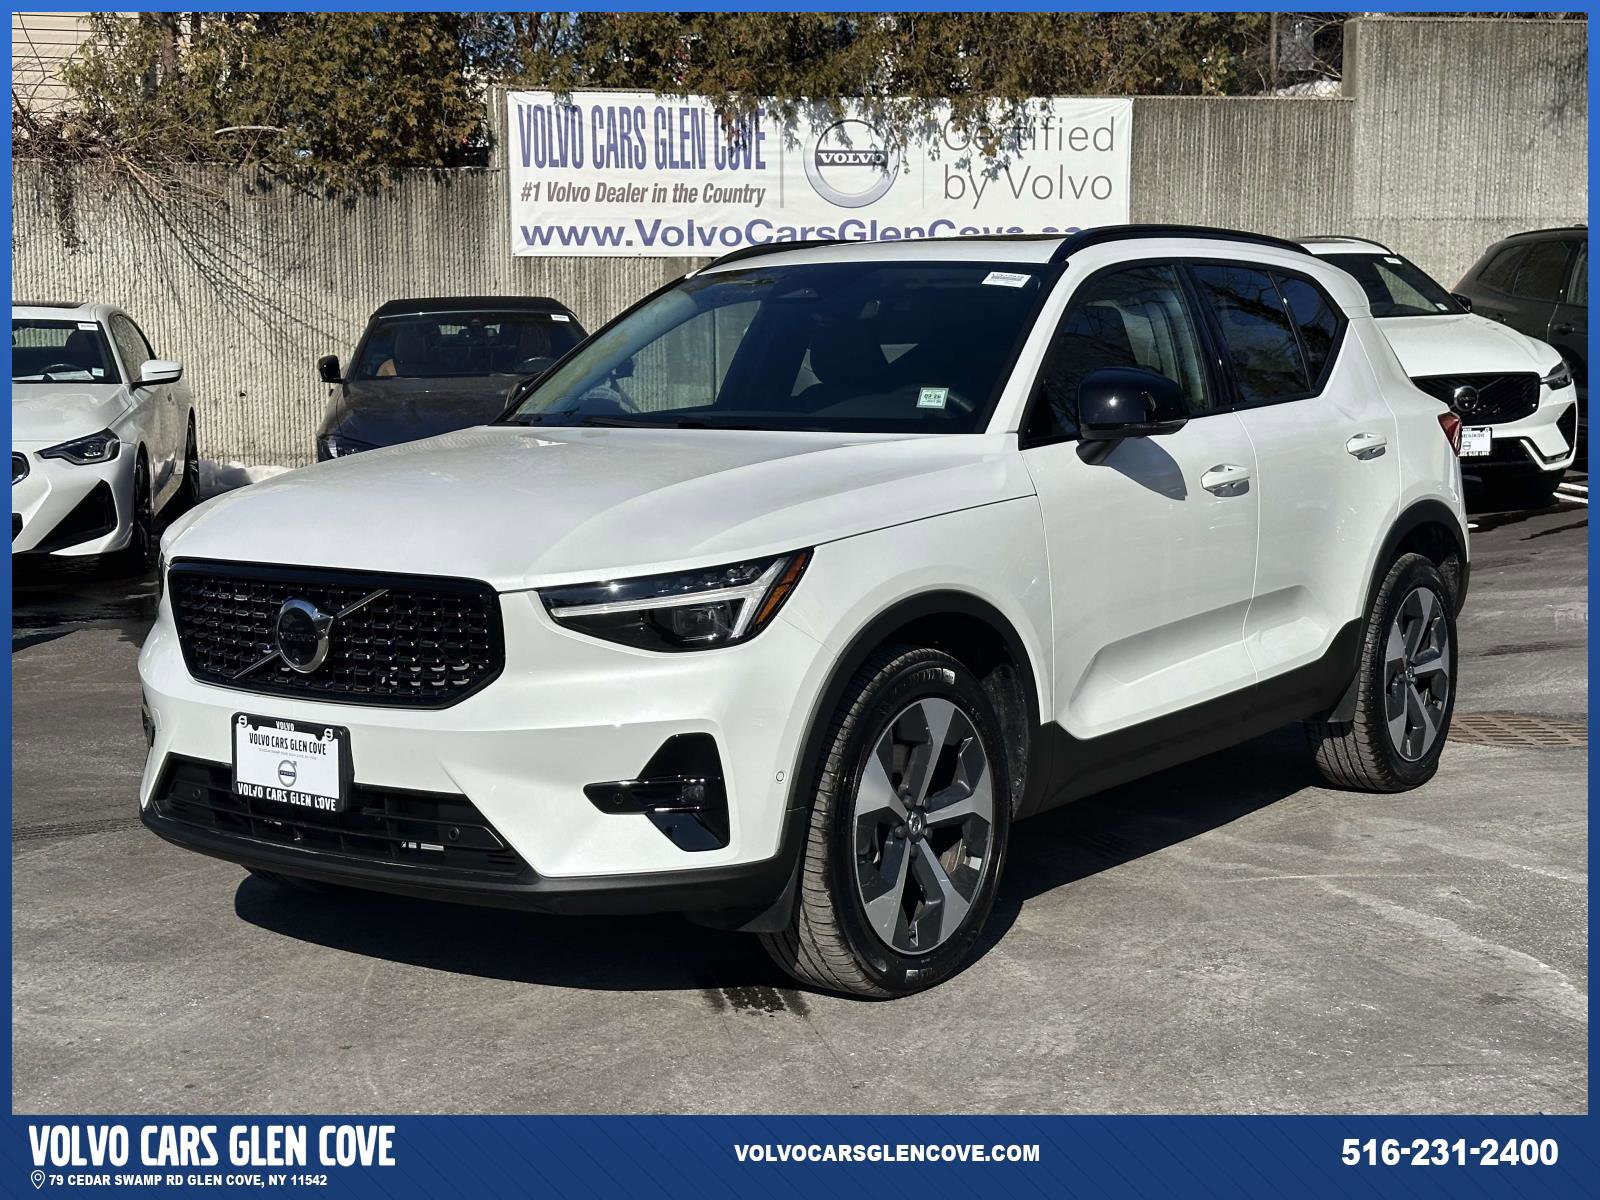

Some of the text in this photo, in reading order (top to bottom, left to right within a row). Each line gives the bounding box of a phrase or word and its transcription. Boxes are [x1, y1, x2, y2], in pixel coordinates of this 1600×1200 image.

[517, 104, 766, 171] VOLVO CARS GLEN COVE
[817, 152, 885, 164] VOLVO
[520, 181, 767, 208] #1 Volvo Dealer in the Country
[943, 164, 1113, 210] by Volvo
[275, 720, 295, 732] VOLVO
[249, 732, 270, 747] VOLVO
[271, 735, 288, 750] CARS
[290, 739, 308, 753] GLEN
[309, 741, 327, 756] COVE
[237, 782, 263, 798] VOLVO
[266, 787, 288, 803] CARS
[290, 791, 312, 807] GLEN
